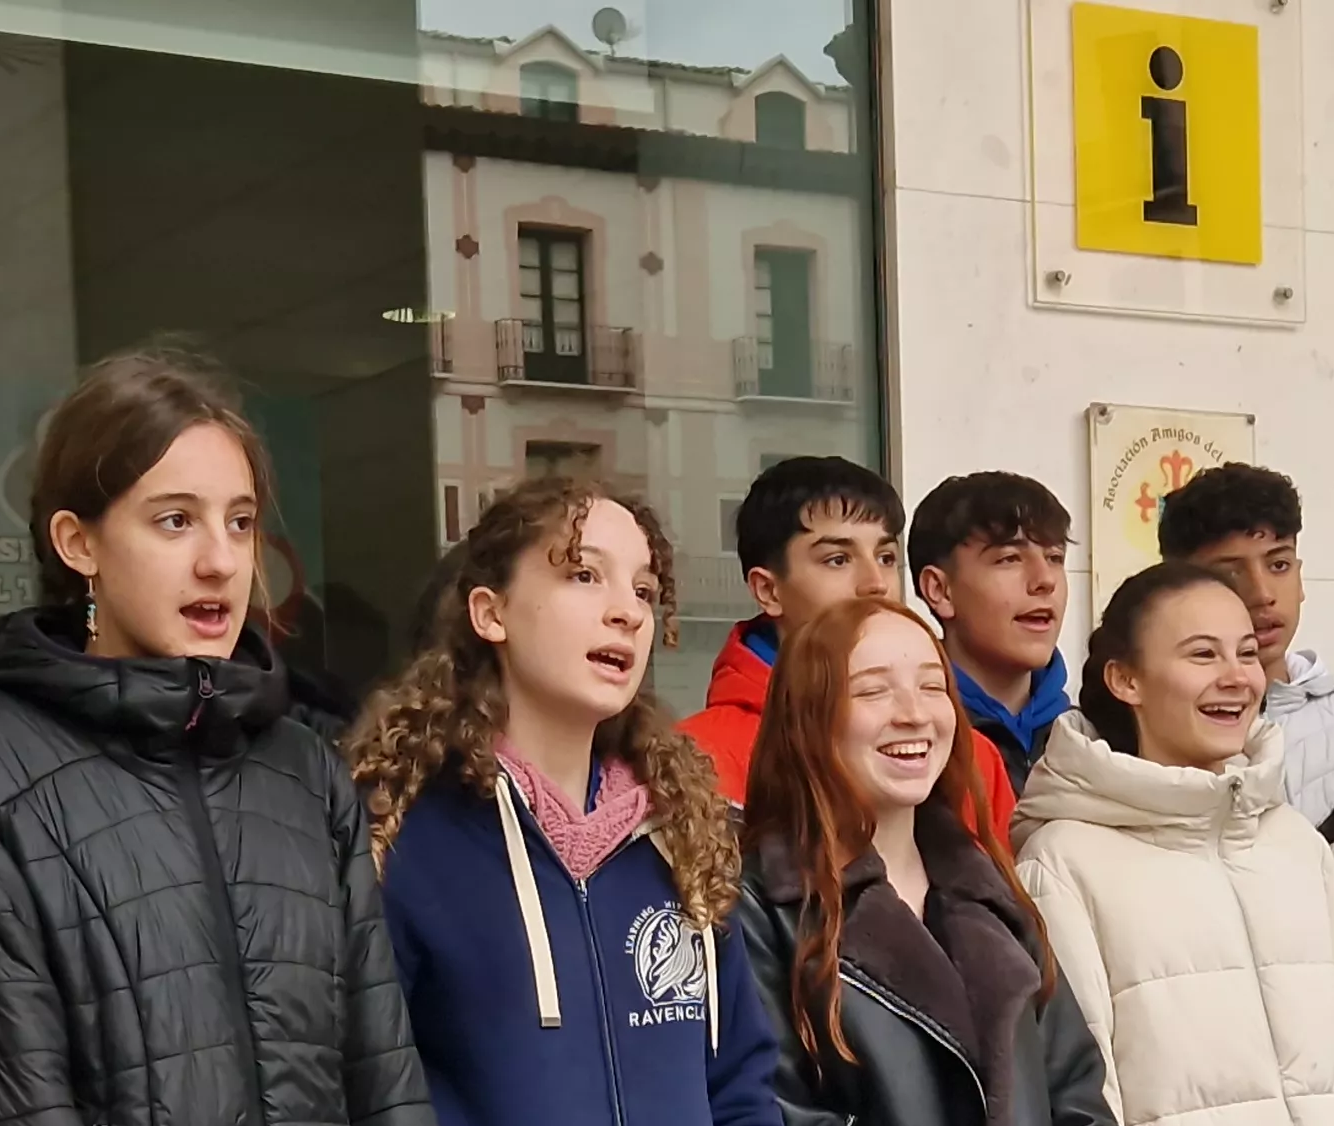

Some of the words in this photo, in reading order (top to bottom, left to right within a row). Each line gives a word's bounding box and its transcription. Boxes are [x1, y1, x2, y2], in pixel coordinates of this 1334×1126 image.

[1140, 46, 1198, 227] i
[1150, 427, 1201, 445] Amigos
[1204, 441, 1223, 462] del
